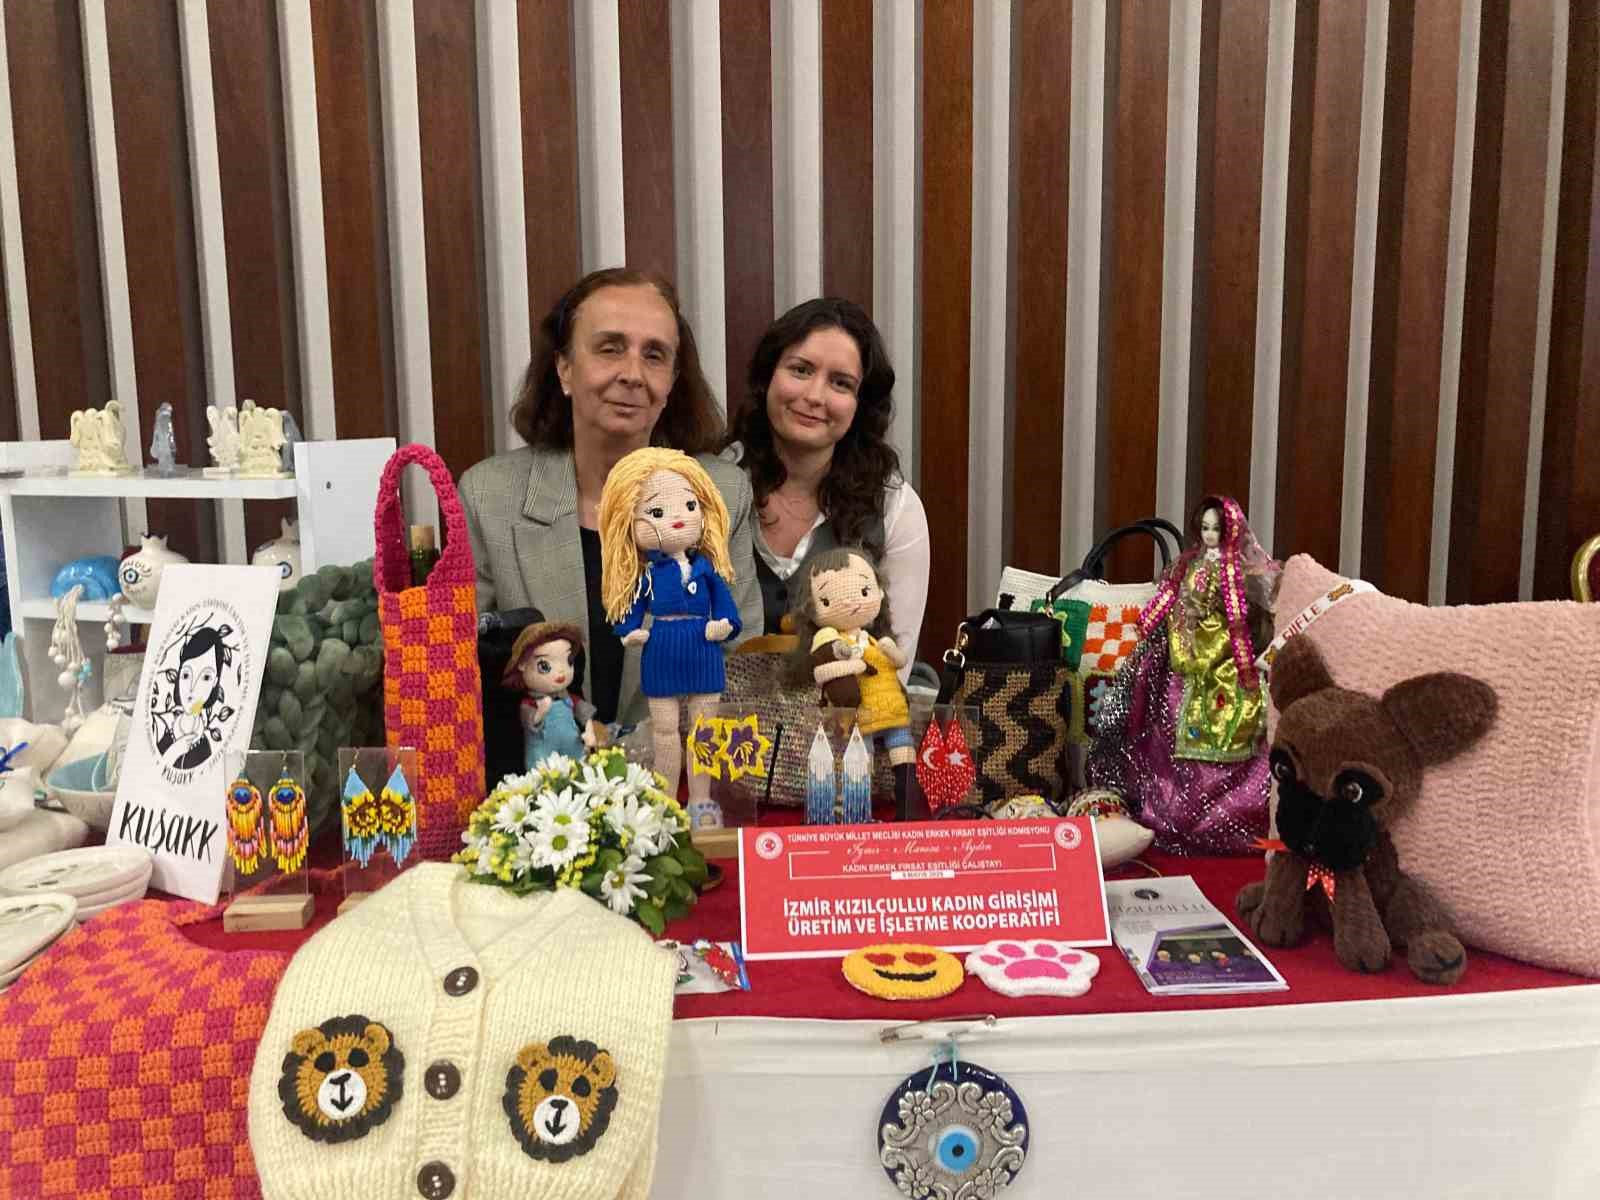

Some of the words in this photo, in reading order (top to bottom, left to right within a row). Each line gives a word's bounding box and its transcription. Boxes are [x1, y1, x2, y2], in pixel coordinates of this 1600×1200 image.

[788, 833, 817, 843] TÜRKİYE
[819, 831, 845, 842] BÜYÜK
[846, 831, 871, 841] MİLLET
[902, 830, 924, 840] KADIN
[925, 829, 949, 839] ERKEK
[842, 864, 868, 873] KADIN
[869, 863, 896, 872] ERKEK
[784, 897, 831, 918] İZMİR
[835, 895, 927, 914] KIZILÇULLU
[932, 894, 984, 912] KADIN
[988, 889, 1058, 912] GİRİŞİMİ
[788, 915, 852, 936] ÜRETİM
[855, 917, 876, 934] VE
[879, 912, 949, 937] İŞLETME
[952, 908, 1060, 931] KOOPERATİFİ
